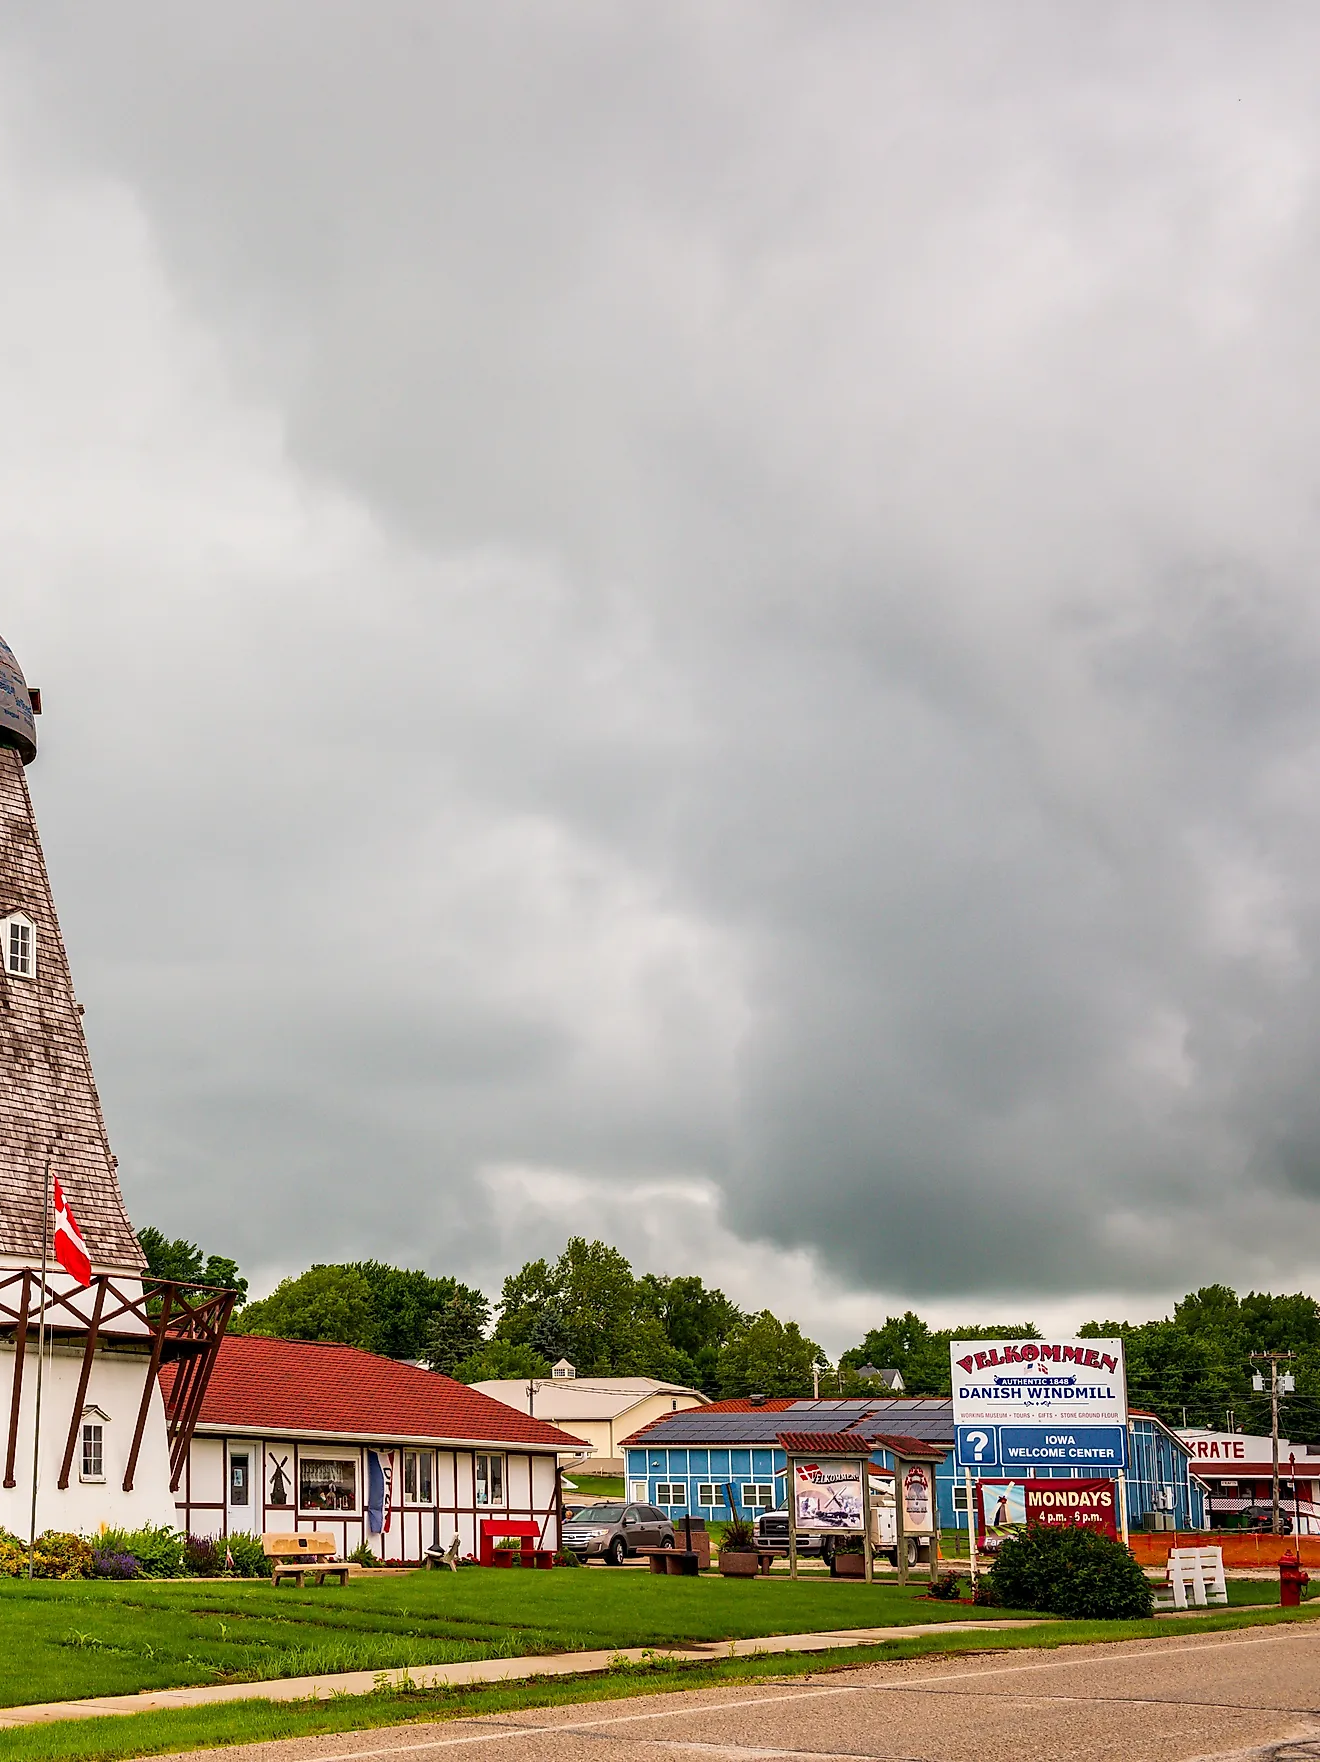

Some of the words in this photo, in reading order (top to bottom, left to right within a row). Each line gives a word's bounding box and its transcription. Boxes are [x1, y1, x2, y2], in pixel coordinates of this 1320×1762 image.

[956, 1344, 1119, 1375] VELKOMMEN
[959, 1387, 1022, 1399] DANISH
[1026, 1387, 1116, 1399] WINDMILL
[1045, 1436, 1076, 1444] IOWA
[1008, 1448, 1066, 1458] WELCOME
[1068, 1448, 1114, 1458] CENTER
[1028, 1492, 1112, 1506] MONDAYS
[1039, 1510, 1046, 1520] 4
[1048, 1512, 1066, 1523] p.m.
[1082, 1512, 1102, 1524] p.m.
